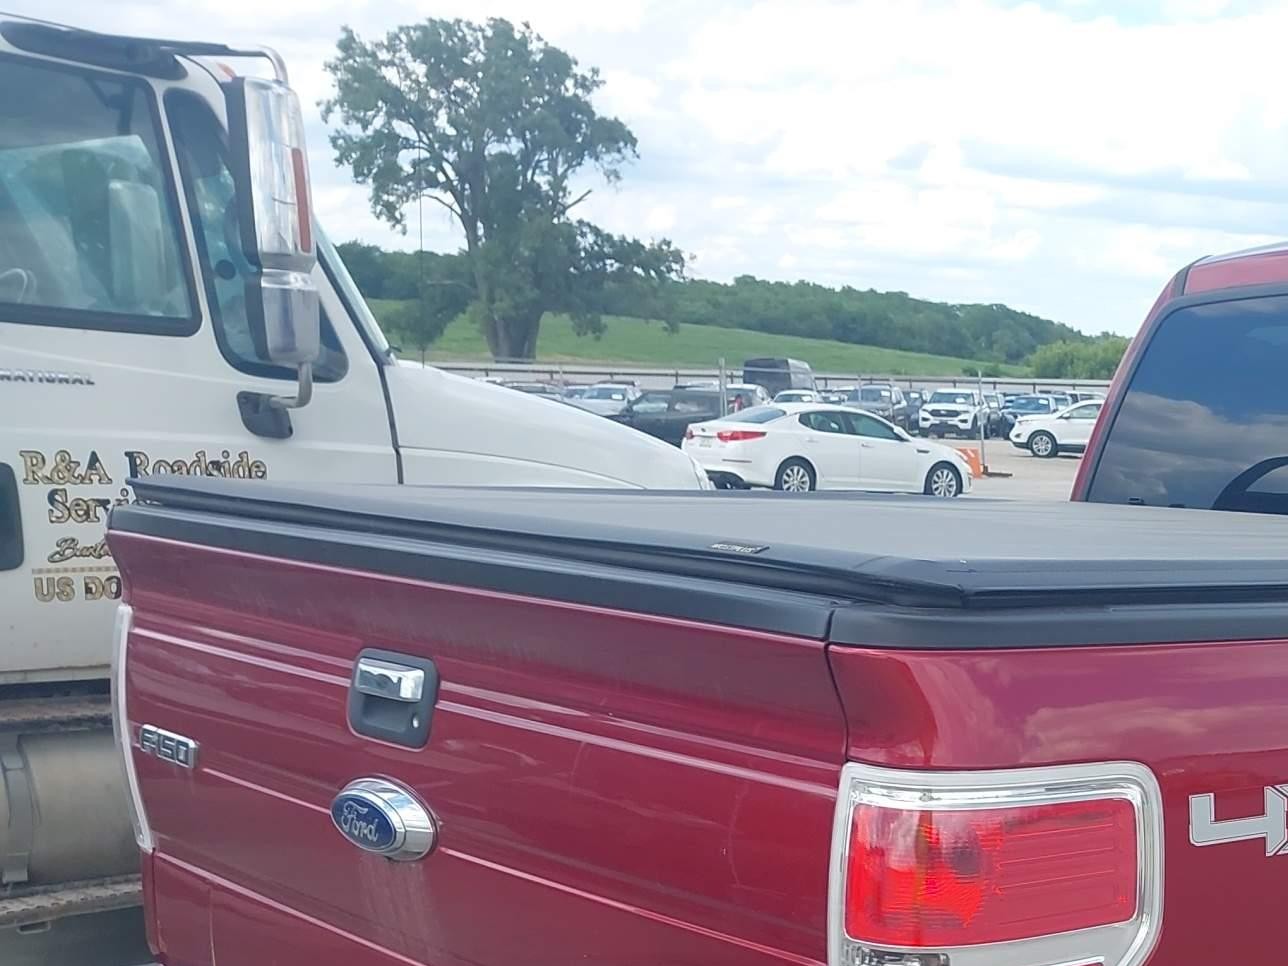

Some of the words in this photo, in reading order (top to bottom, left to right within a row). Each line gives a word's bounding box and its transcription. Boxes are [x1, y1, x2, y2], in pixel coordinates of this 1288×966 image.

[19, 450, 112, 485] R&A
[125, 449, 268, 481] Roadside
[33, 576, 75, 602] US
[84, 576, 122, 600] DO
[341, 800, 380, 842] Ford
